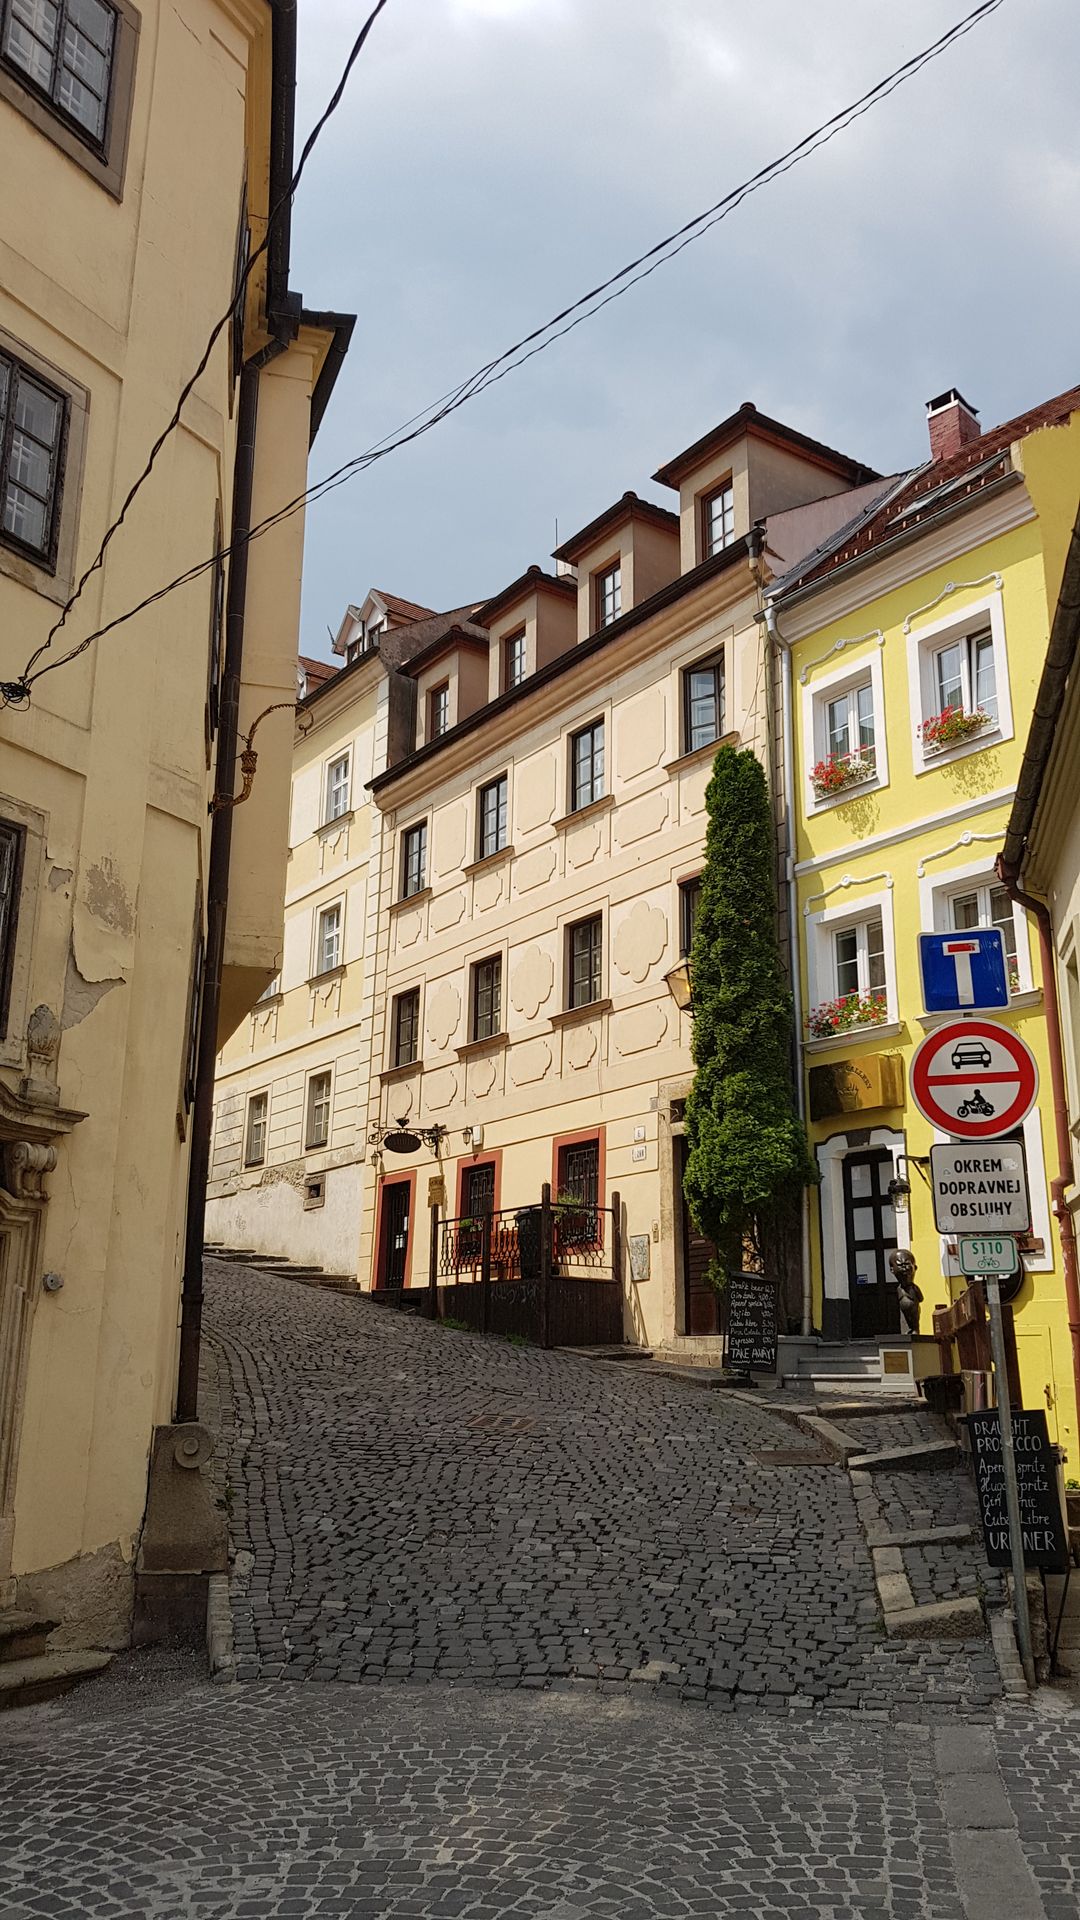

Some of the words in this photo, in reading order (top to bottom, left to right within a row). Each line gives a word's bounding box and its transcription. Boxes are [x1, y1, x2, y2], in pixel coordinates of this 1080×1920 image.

[846, 1065, 873, 1091] GALLERY
[954, 1159, 1002, 1173] OKREM
[939, 1180, 1020, 1195] DOPRAVNEJ
[950, 1202, 1012, 1217] OBSLUHY
[972, 1242, 1003, 1255] S110
[730, 1348, 749, 1359] TAKE
[974, 1419, 1030, 1435] DRAUHT
[977, 1435, 1041, 1453] PROCCO
[979, 1456, 1006, 1479] Aper
[1017, 1456, 1047, 1479] spritz
[983, 1494, 1001, 1507] Gin
[1020, 1509, 1050, 1525] Libre
[989, 1531, 1056, 1551] URNER
